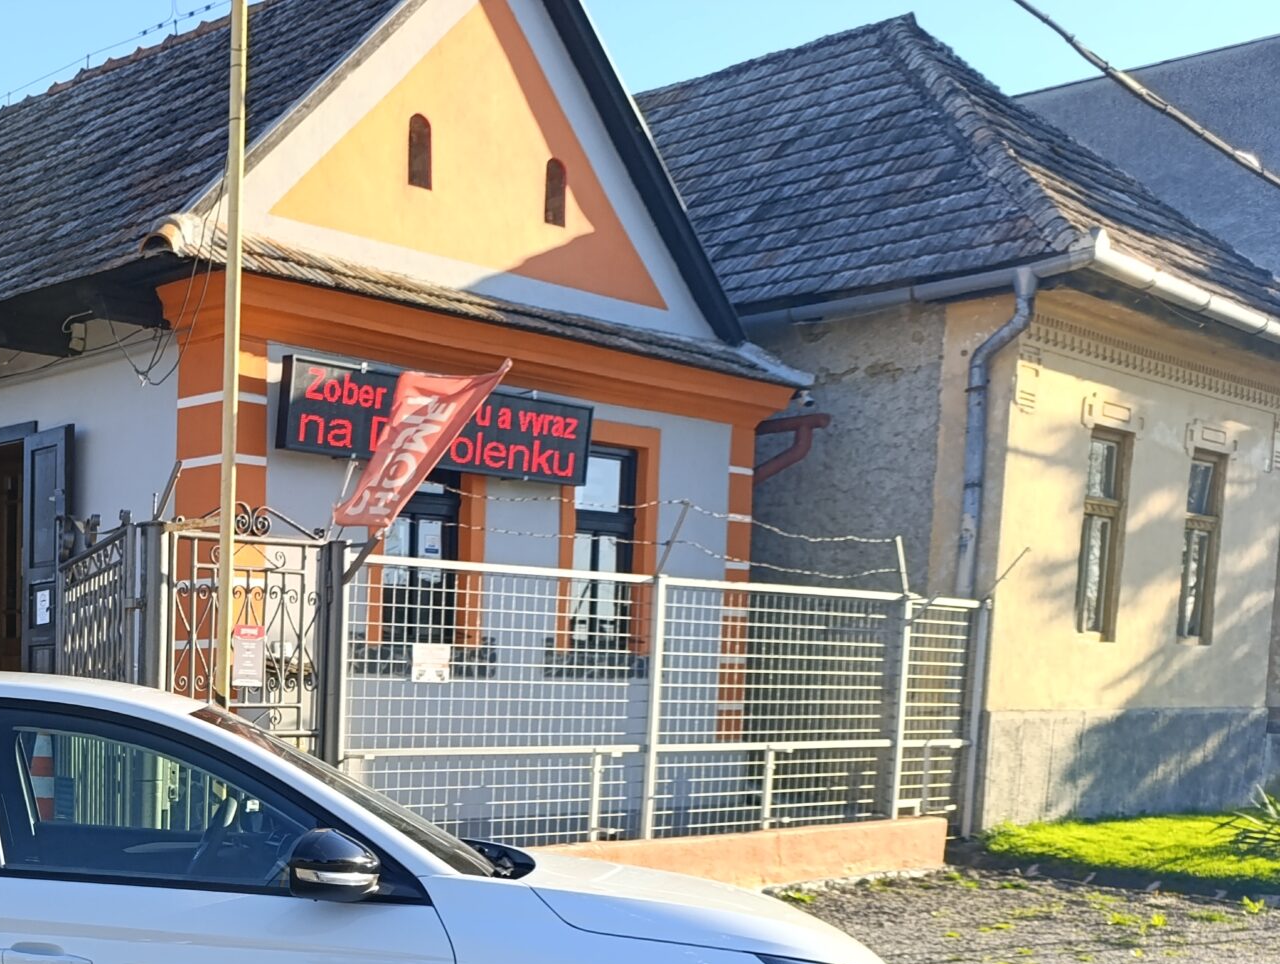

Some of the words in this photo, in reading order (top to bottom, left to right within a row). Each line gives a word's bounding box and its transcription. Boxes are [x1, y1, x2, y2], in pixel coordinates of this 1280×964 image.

[305, 367, 387, 409] Zober
[299, 414, 353, 448] na
[497, 407, 512, 429] a
[518, 410, 578, 439] vyraz
